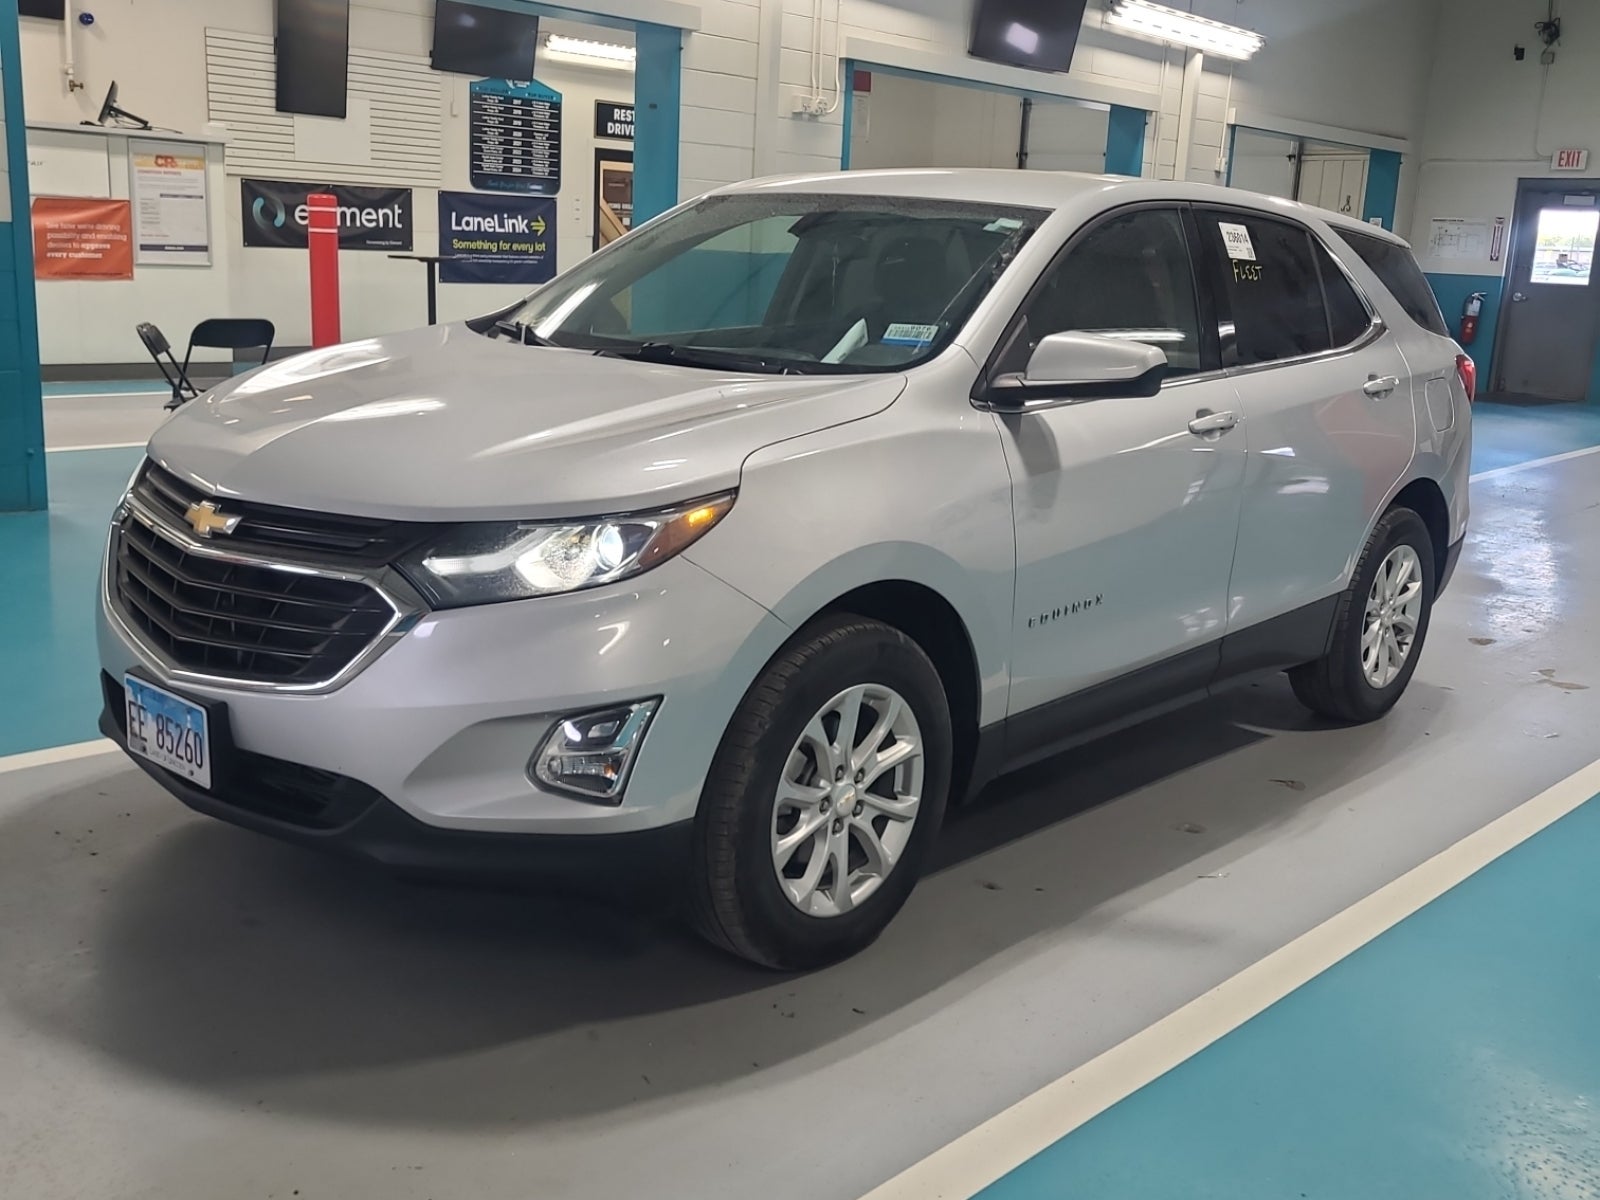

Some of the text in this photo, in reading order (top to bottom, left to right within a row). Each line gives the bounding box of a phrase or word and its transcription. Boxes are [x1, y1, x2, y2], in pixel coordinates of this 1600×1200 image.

[1558, 151, 1582, 167] EXIT
[294, 204, 403, 229] ement
[451, 211, 529, 234] LaneLink
[452, 238, 546, 254] Something for every lot
[1028, 593, 1103, 628] EQUINOX
[156, 713, 203, 769] 85260
